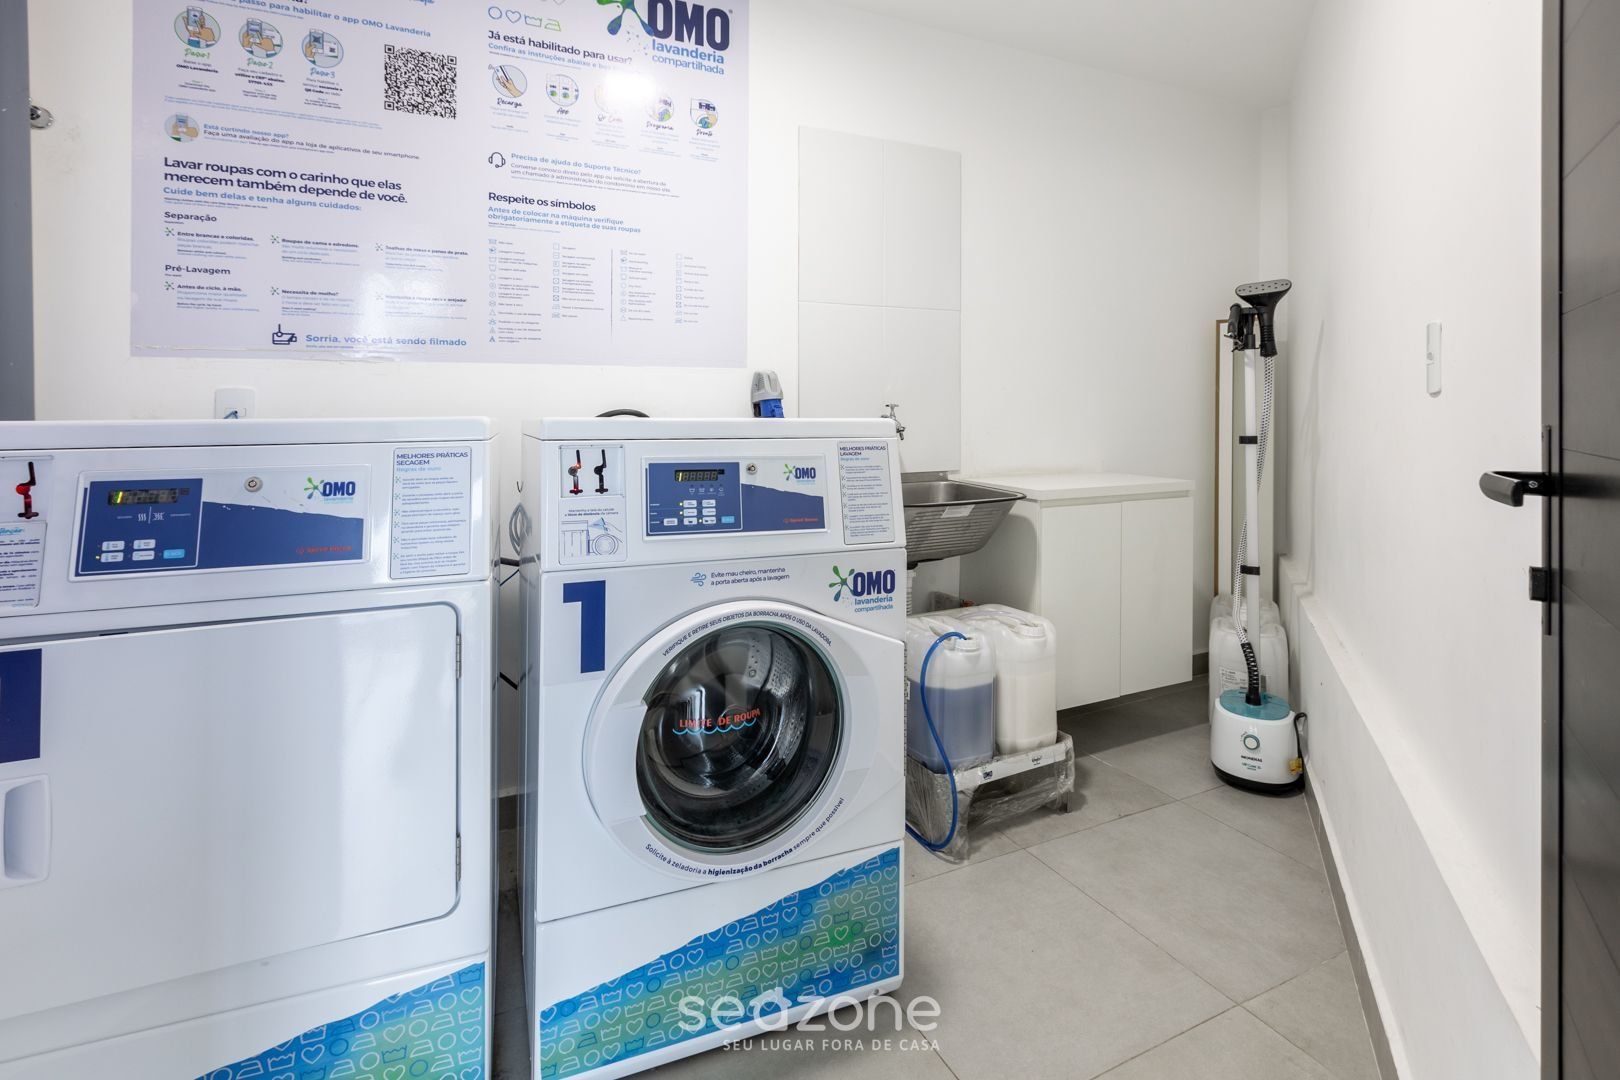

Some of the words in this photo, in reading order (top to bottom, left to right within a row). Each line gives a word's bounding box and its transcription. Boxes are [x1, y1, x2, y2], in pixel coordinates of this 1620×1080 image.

[293, 6, 331, 18] habilitar
[386, 24, 430, 37] Lavanderia
[648, 0, 730, 51] OMO
[488, 31, 500, 40] Já
[503, 34, 525, 45] está
[528, 38, 580, 55] habilitado
[583, 50, 605, 60] para
[607, 55, 632, 64] usar?
[488, 43, 515, 53] Confira
[528, 50, 565, 62] instruções
[652, 39, 724, 64] lavanderia
[652, 54, 724, 75] compartilhada
[497, 98, 522, 108] Recarga
[239, 133, 269, 143] avaliação
[384, 151, 420, 160] smartphone.
[511, 152, 538, 163] Precisa
[551, 158, 570, 168] ajuda
[584, 161, 610, 171] Suporte
[164, 157, 203, 170] Lavar
[206, 162, 253, 176] roupas
[256, 168, 286, 178] com
[289, 171, 298, 180] o
[300, 170, 348, 185] carinho
[351, 177, 375, 189] que
[378, 178, 402, 191] elas
[164, 172, 233, 186] merecem
[237, 178, 296, 193] também
[299, 183, 361, 199] depende
[363, 189, 375, 200] de
[378, 191, 408, 203] você.
[163, 187, 193, 196] Cuide
[196, 188, 218, 198] bem
[222, 190, 246, 201] delas
[256, 194, 284, 205] tenha
[286, 197, 316, 208] alguns
[319, 200, 362, 212] cuidados:
[488, 192, 535, 205] Respeite
[550, 199, 596, 211] símbolos
[164, 211, 217, 222] Separação
[488, 213, 553, 225] obrigatoriamente
[561, 213, 592, 223] máquina
[165, 264, 231, 275] Pré-Lavagem
[305, 334, 340, 343] Sorria,
[429, 338, 467, 346] filmado
[795, 468, 816, 479] OMO
[322, 481, 356, 497] OMO
[852, 570, 895, 597] OMO
[854, 596, 893, 605] lavanderia
[854, 604, 893, 613] compartilhada
[563, 580, 606, 673] 1
[662, 635, 687, 657] VERIFIQUE
[692, 624, 709, 635] RETIRE
[709, 619, 722, 627] SEUS
[722, 612, 744, 622] OBJETOS
[680, 719, 712, 728] LIMITE
[718, 716, 731, 725] DE
[734, 708, 760, 722] ROUPA
[645, 844, 666, 862] Solicite
[672, 861, 701, 874] zeladoria
[708, 865, 752, 876] higienização
[763, 848, 793, 866] borracha
[793, 831, 815, 850] sempre
[815, 821, 826, 833] que
[826, 797, 844, 822] possível
